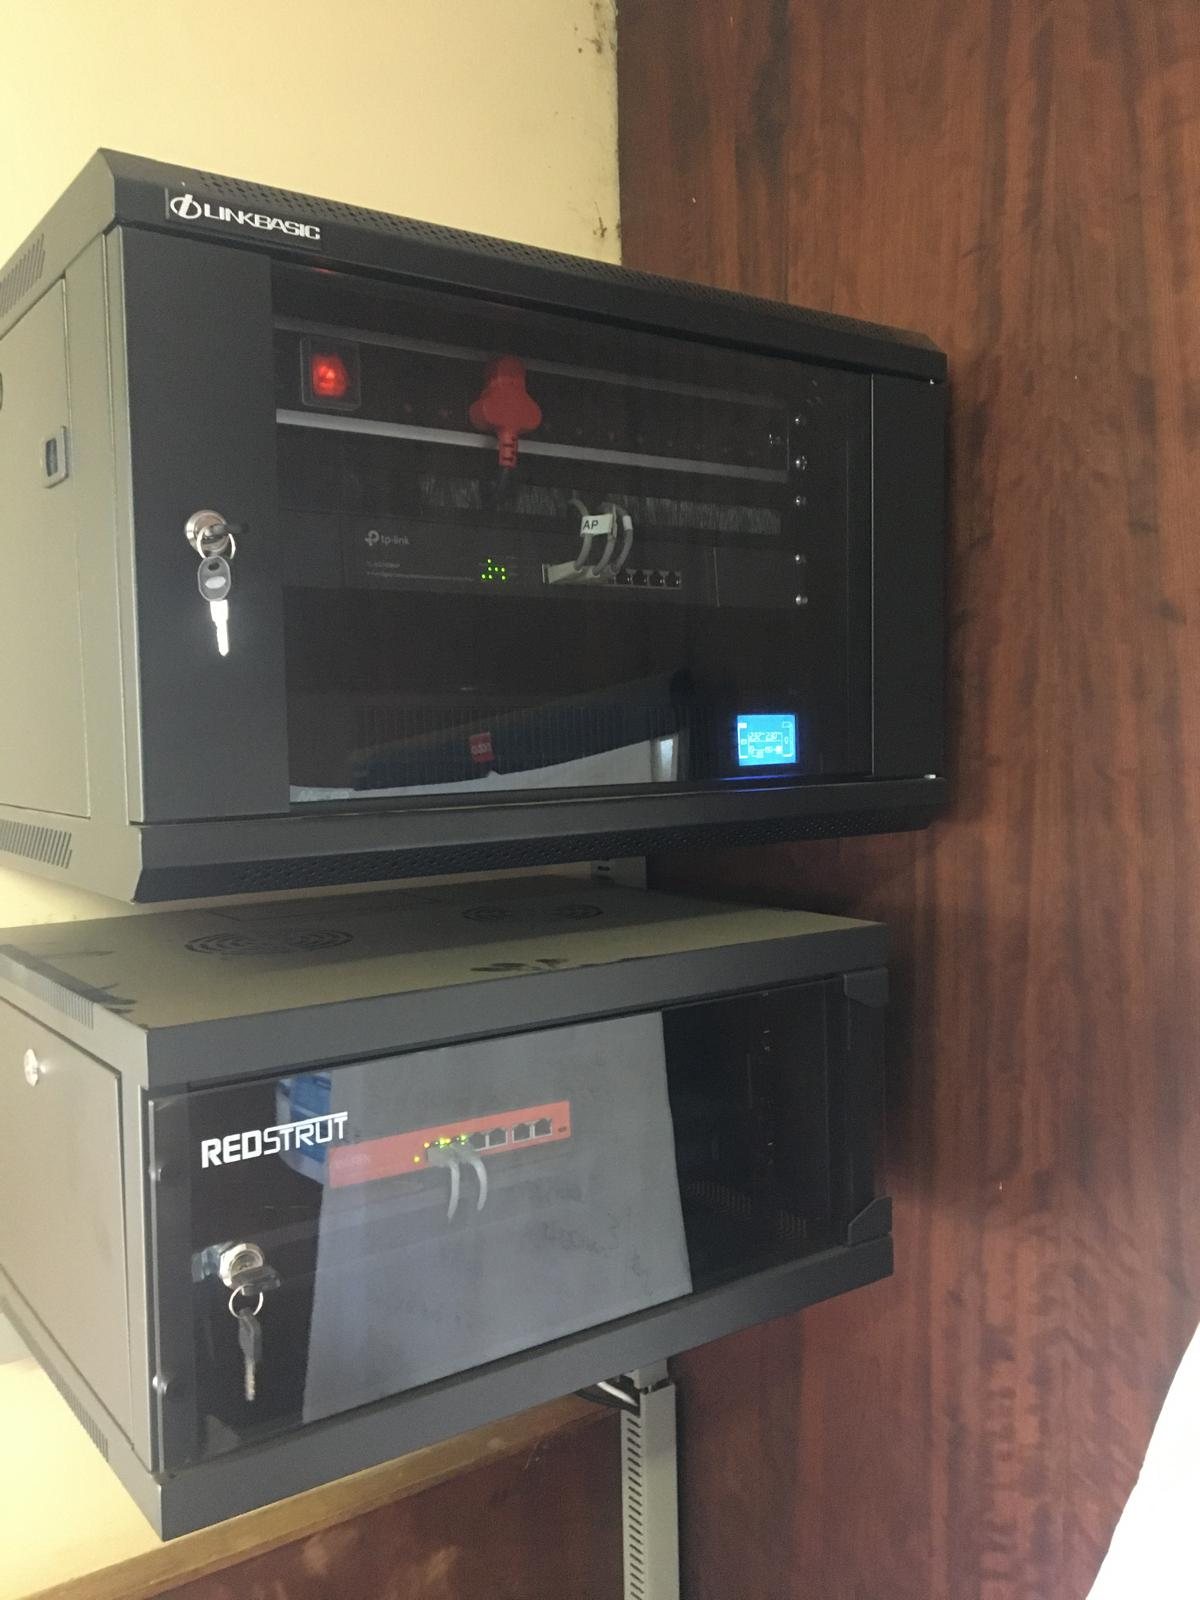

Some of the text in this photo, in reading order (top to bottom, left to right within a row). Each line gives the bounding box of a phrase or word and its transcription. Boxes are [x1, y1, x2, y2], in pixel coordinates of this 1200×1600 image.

[203, 203, 321, 240] LINKBASIC
[583, 519, 599, 530] AP
[381, 535, 410, 546] tp-link
[201, 1111, 348, 1169] REDSTRUT
